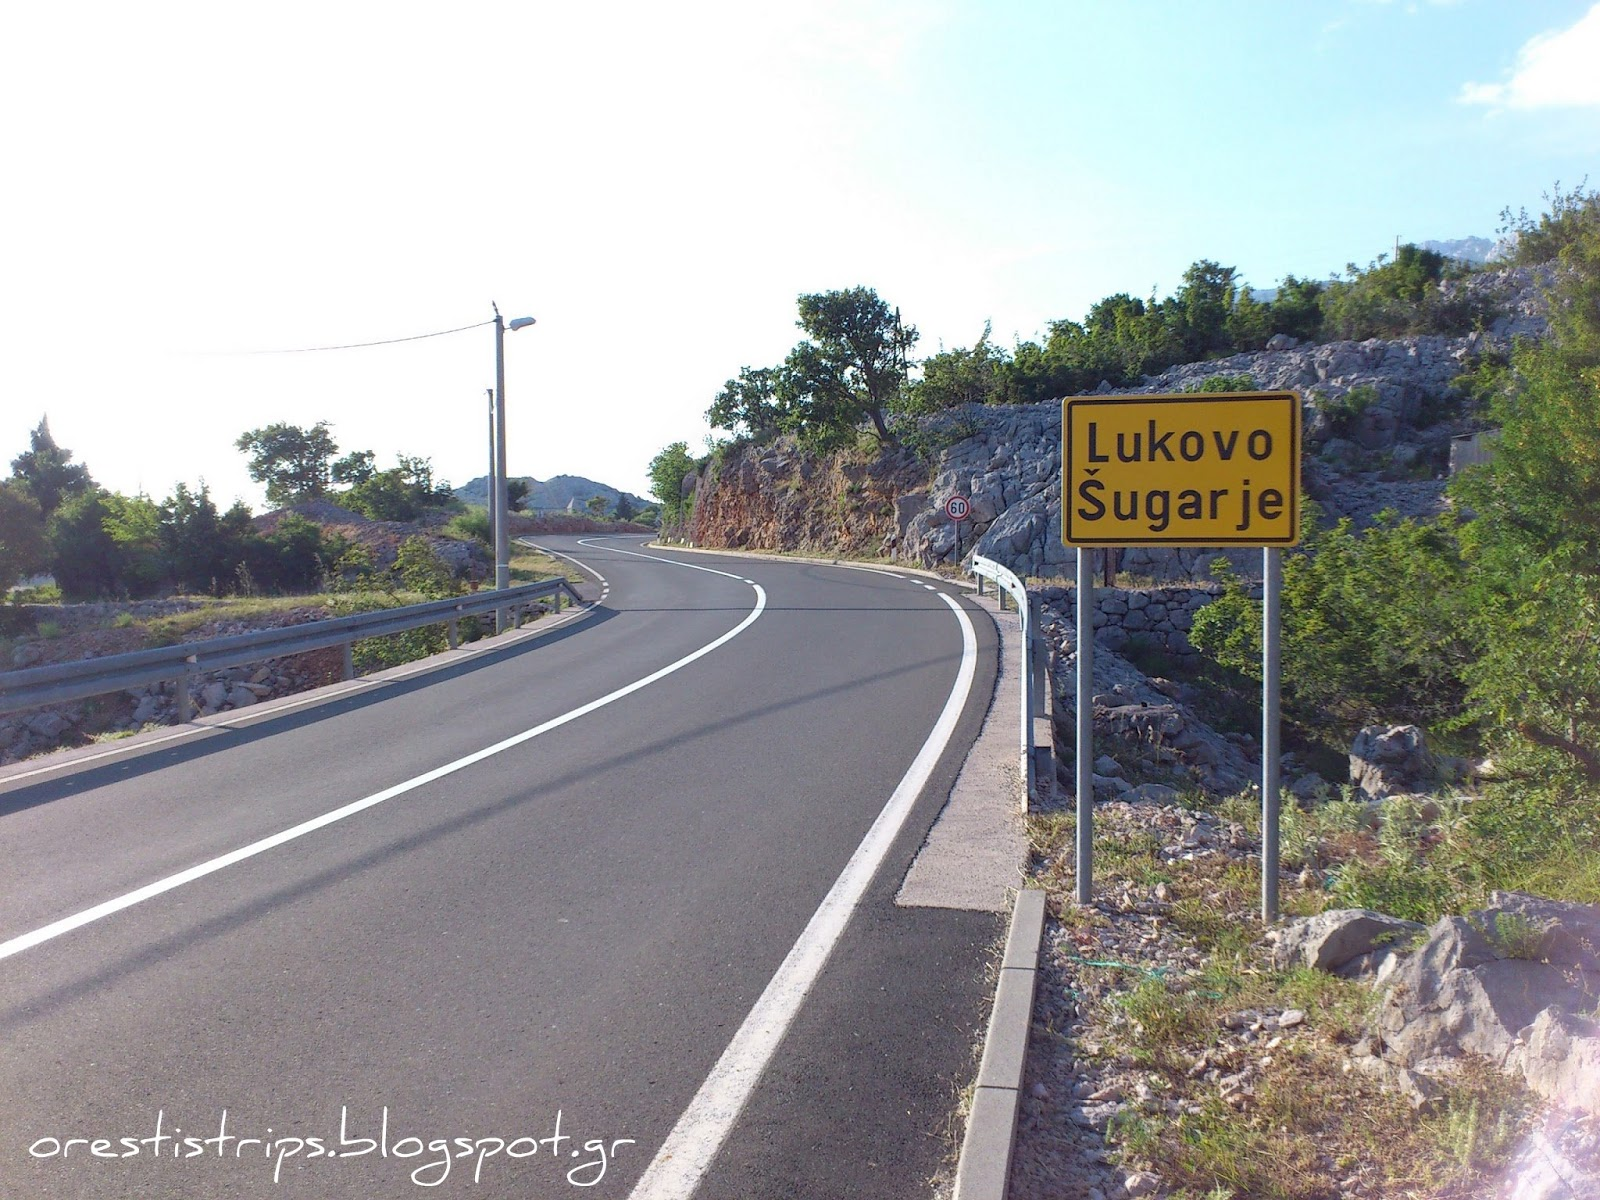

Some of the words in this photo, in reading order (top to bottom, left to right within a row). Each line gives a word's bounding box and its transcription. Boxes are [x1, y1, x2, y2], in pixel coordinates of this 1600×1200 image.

[1088, 420, 1273, 463] Lukovo
[951, 502, 965, 514] 60
[1078, 469, 1283, 532] Šugarje
